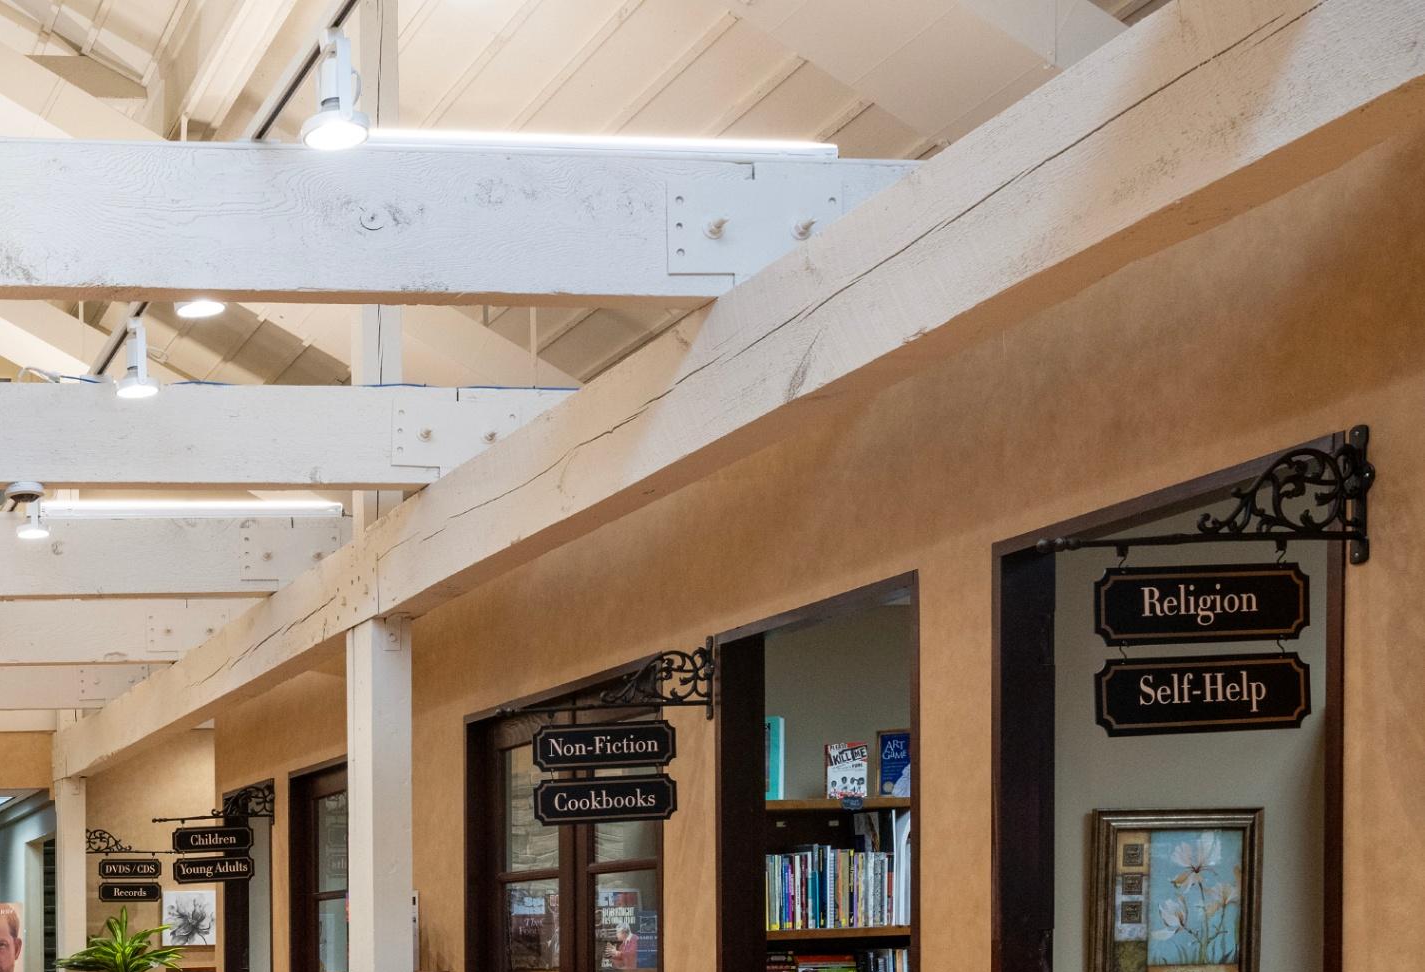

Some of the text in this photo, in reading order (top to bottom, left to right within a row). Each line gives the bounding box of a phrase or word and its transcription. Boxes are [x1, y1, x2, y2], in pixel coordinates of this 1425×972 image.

[1141, 584, 1258, 626] Religion
[1139, 671, 1266, 712] Self-Help
[548, 735, 658, 757] Non-Fiction
[884, 740, 906, 752] ART
[832, 748, 867, 766] KILL ME
[882, 750, 908, 760] GAME
[554, 789, 656, 811] Cookbooks
[190, 833, 236, 846] Children
[180, 861, 248, 877] Young Adults
[113, 887, 147, 897] Records
